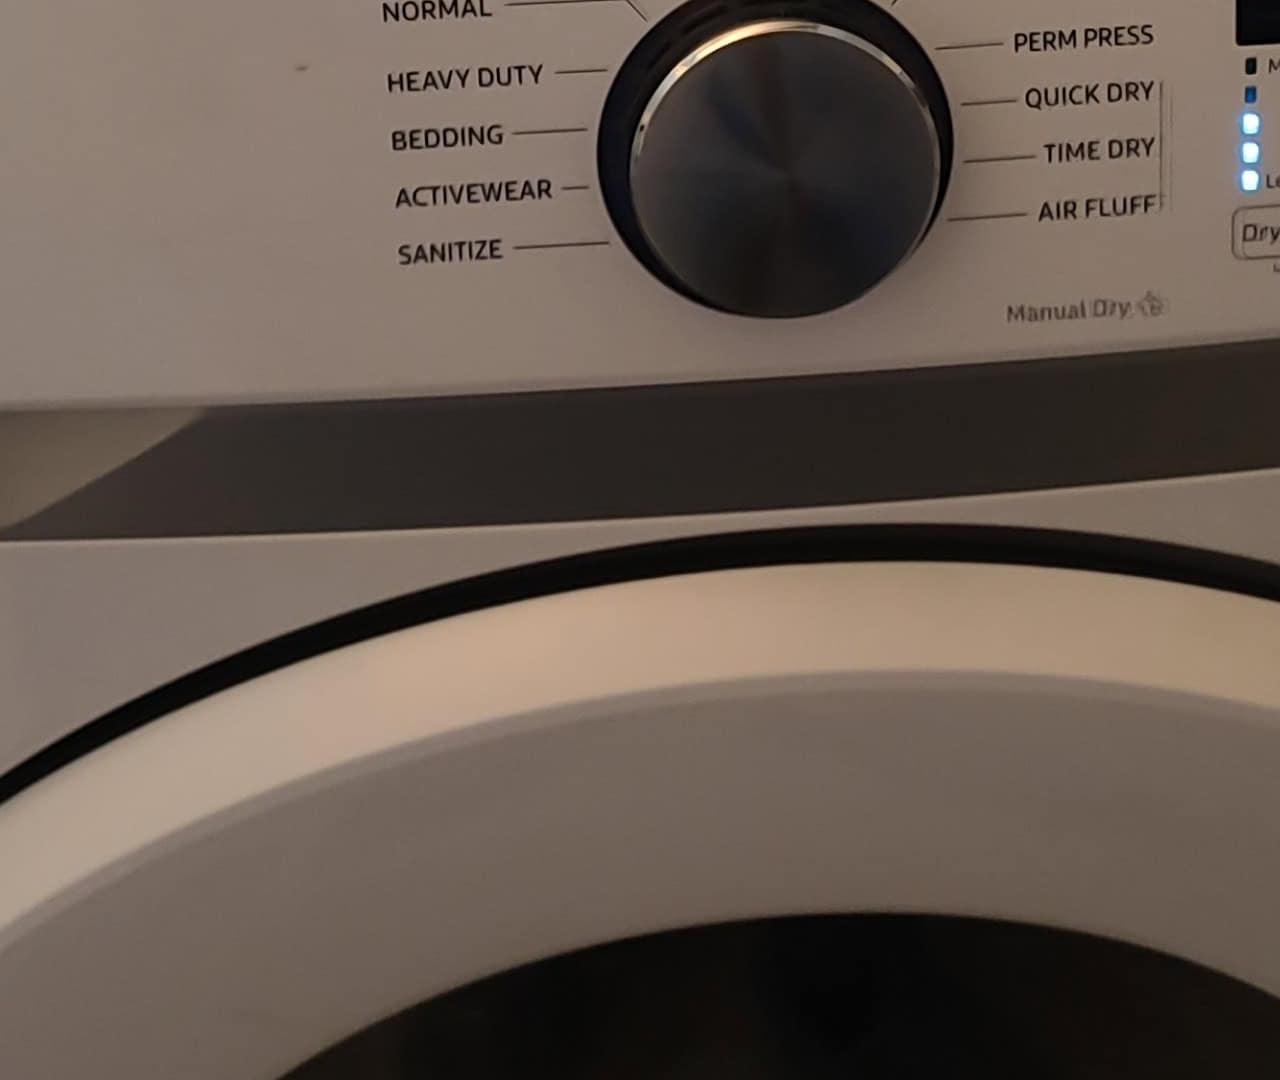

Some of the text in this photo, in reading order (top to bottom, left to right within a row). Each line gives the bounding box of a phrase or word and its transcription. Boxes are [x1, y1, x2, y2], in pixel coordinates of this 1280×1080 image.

[1014, 24, 1154, 53] PERM PRESS
[387, 63, 545, 93] HEAVY DUTY
[1025, 80, 1155, 110] QUICK DRY
[391, 125, 504, 151] BEDDING
[1043, 136, 1156, 164] TIME DRY
[395, 179, 553, 209] ACTIVEWEAR
[1038, 194, 1157, 223] AIR FLUFF
[398, 239, 504, 266] SANITIZE
[1006, 298, 1132, 324] Manual Dry
